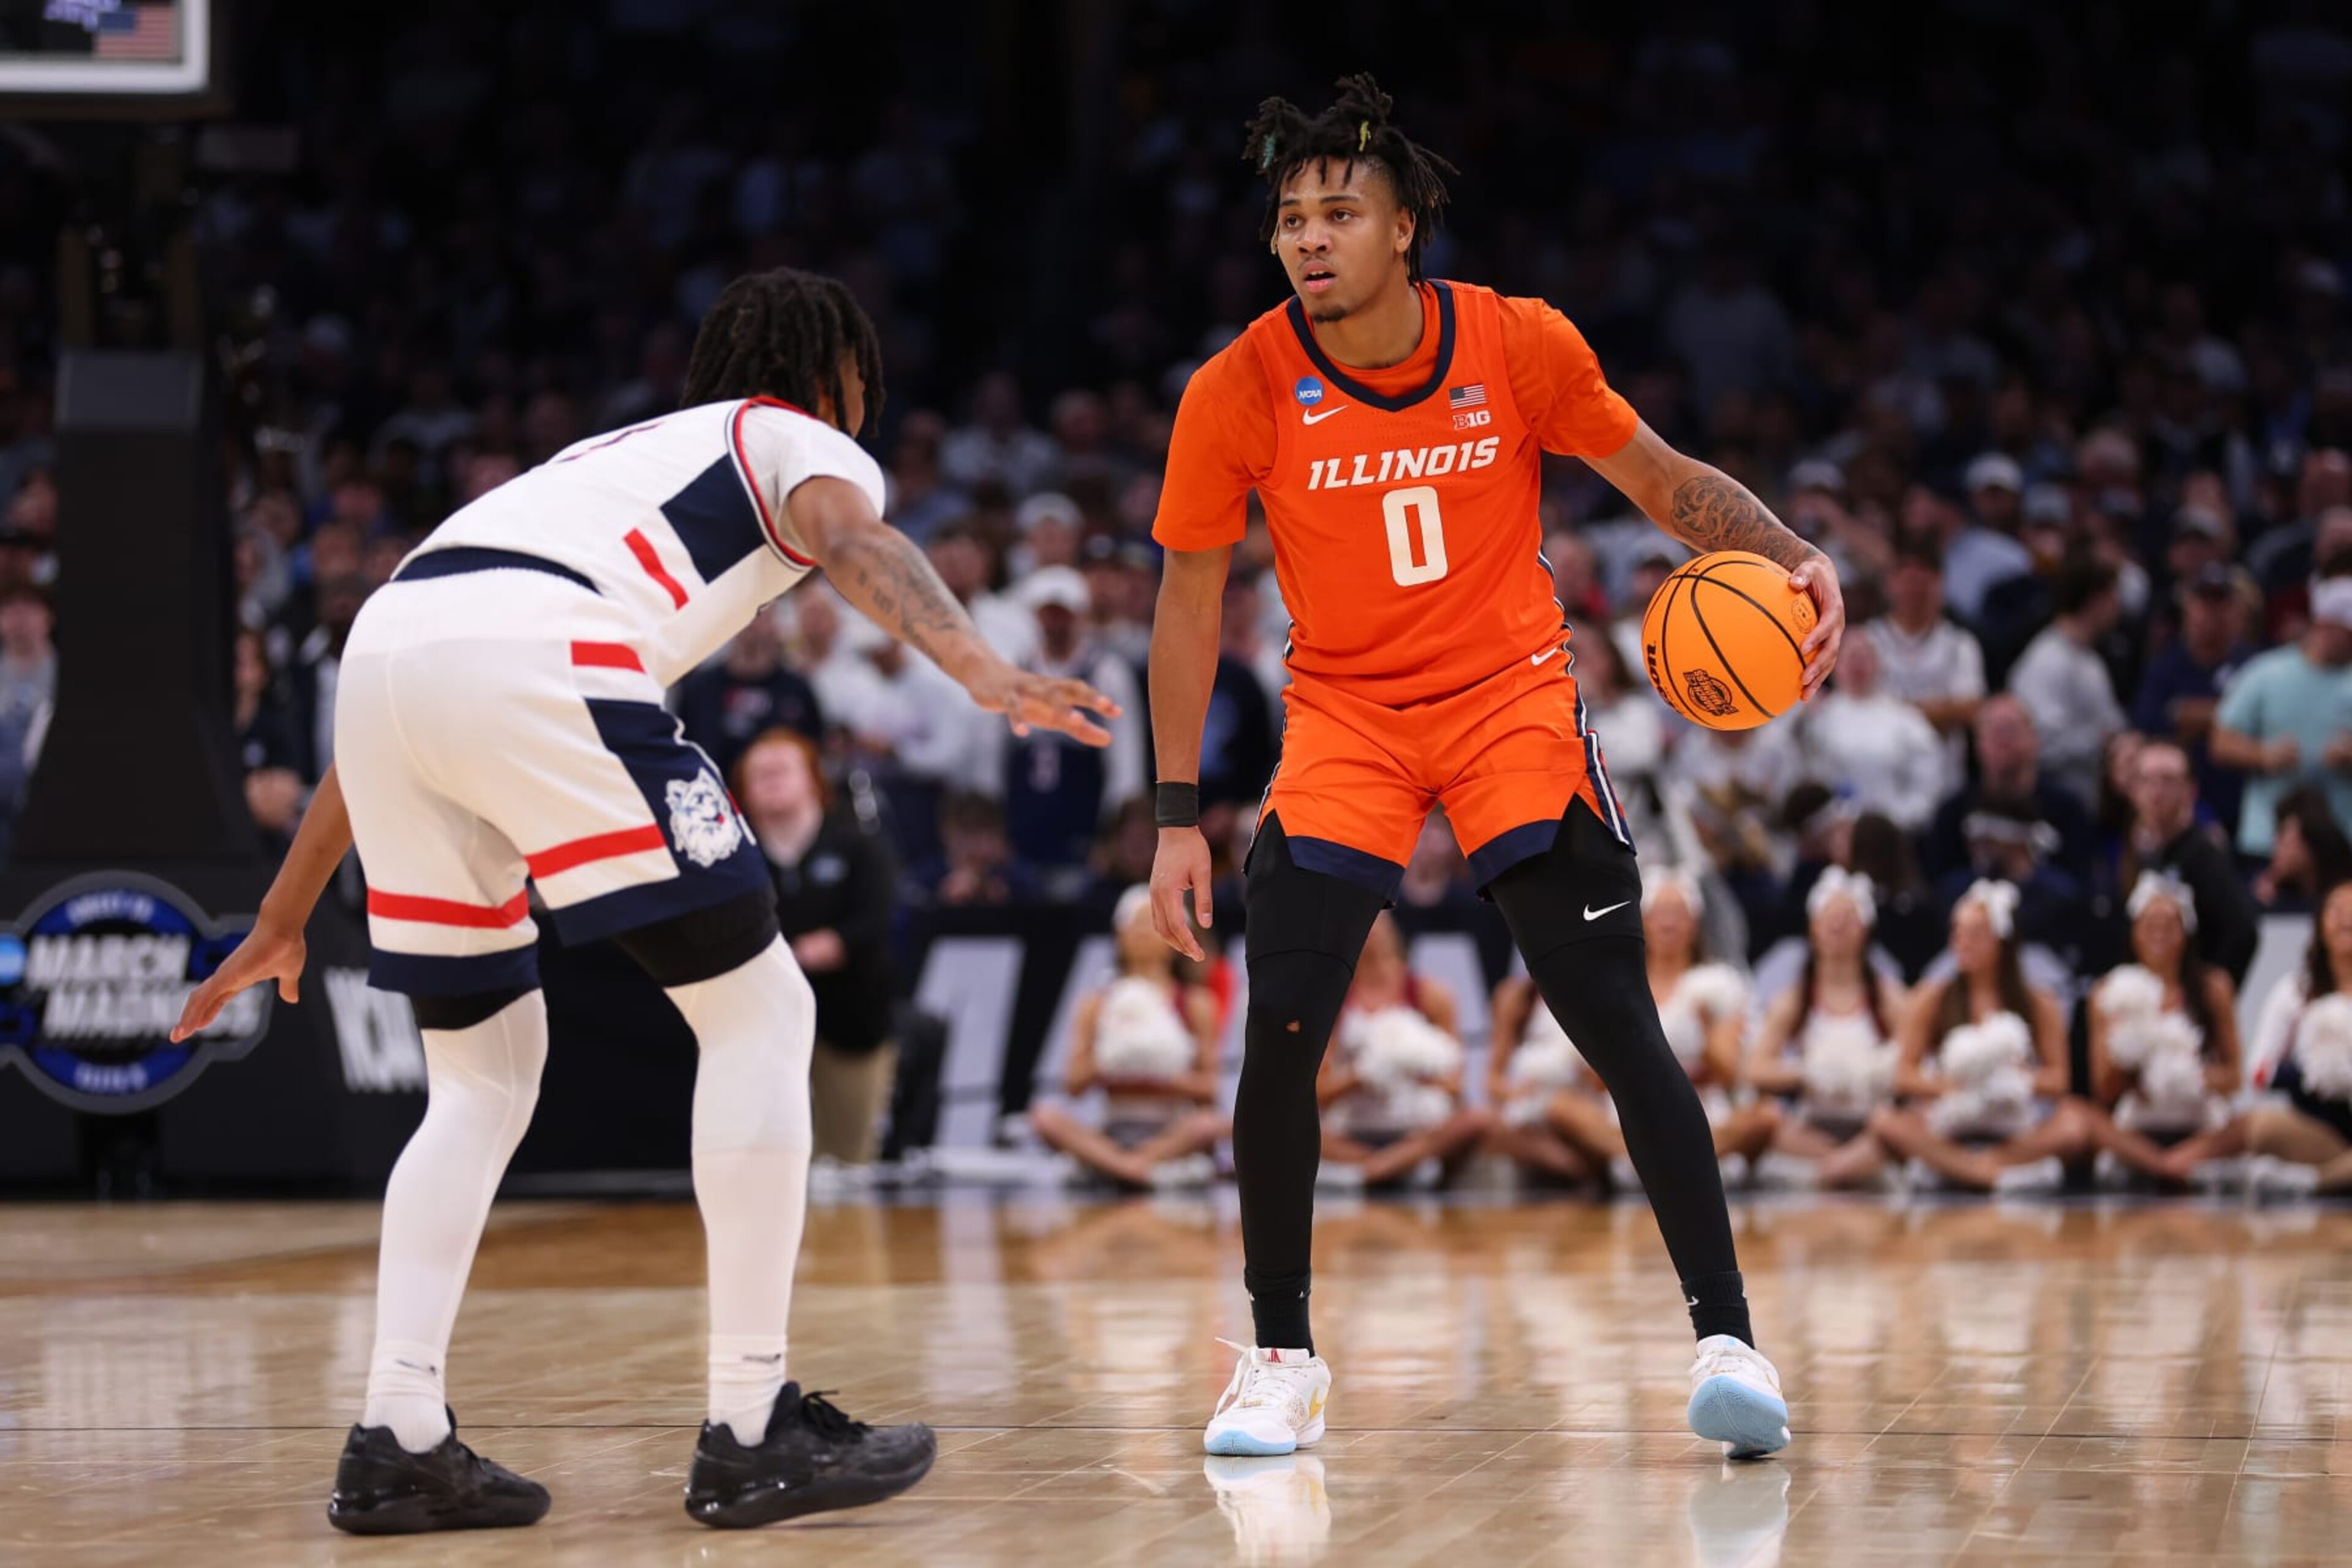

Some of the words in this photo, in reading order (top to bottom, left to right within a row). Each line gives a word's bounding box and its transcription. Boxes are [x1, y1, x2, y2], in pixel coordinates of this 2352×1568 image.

[1298, 389, 1322, 399] NCAA
[1452, 410, 1491, 430] B1G
[1307, 435, 1501, 490] ILLINOIS
[1382, 486, 1448, 587] 0
[26, 934, 190, 987] MARCH
